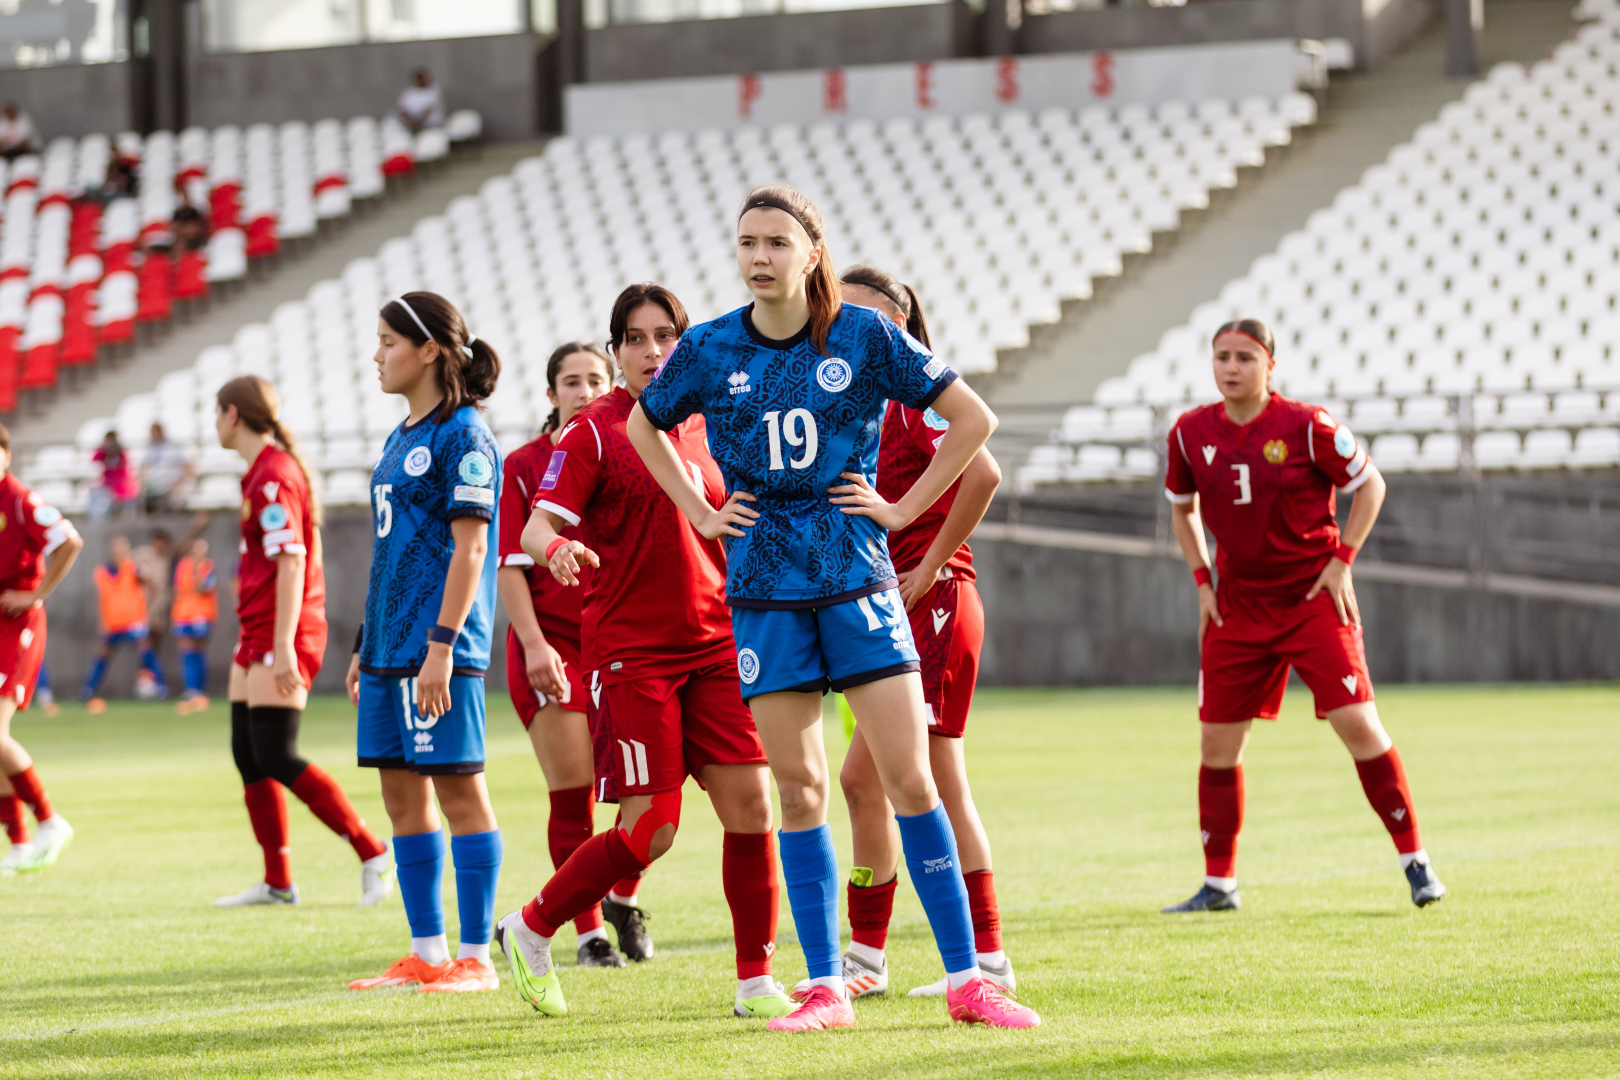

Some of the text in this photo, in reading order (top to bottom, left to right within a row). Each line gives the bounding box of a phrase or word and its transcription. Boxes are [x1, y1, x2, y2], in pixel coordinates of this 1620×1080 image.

[737, 51, 1116, 119] PRESS
[762, 407, 819, 471] 19
[1230, 463, 1252, 506] 3
[373, 484, 393, 539] 15
[856, 588, 903, 632] 19
[617, 738, 650, 787] 11
